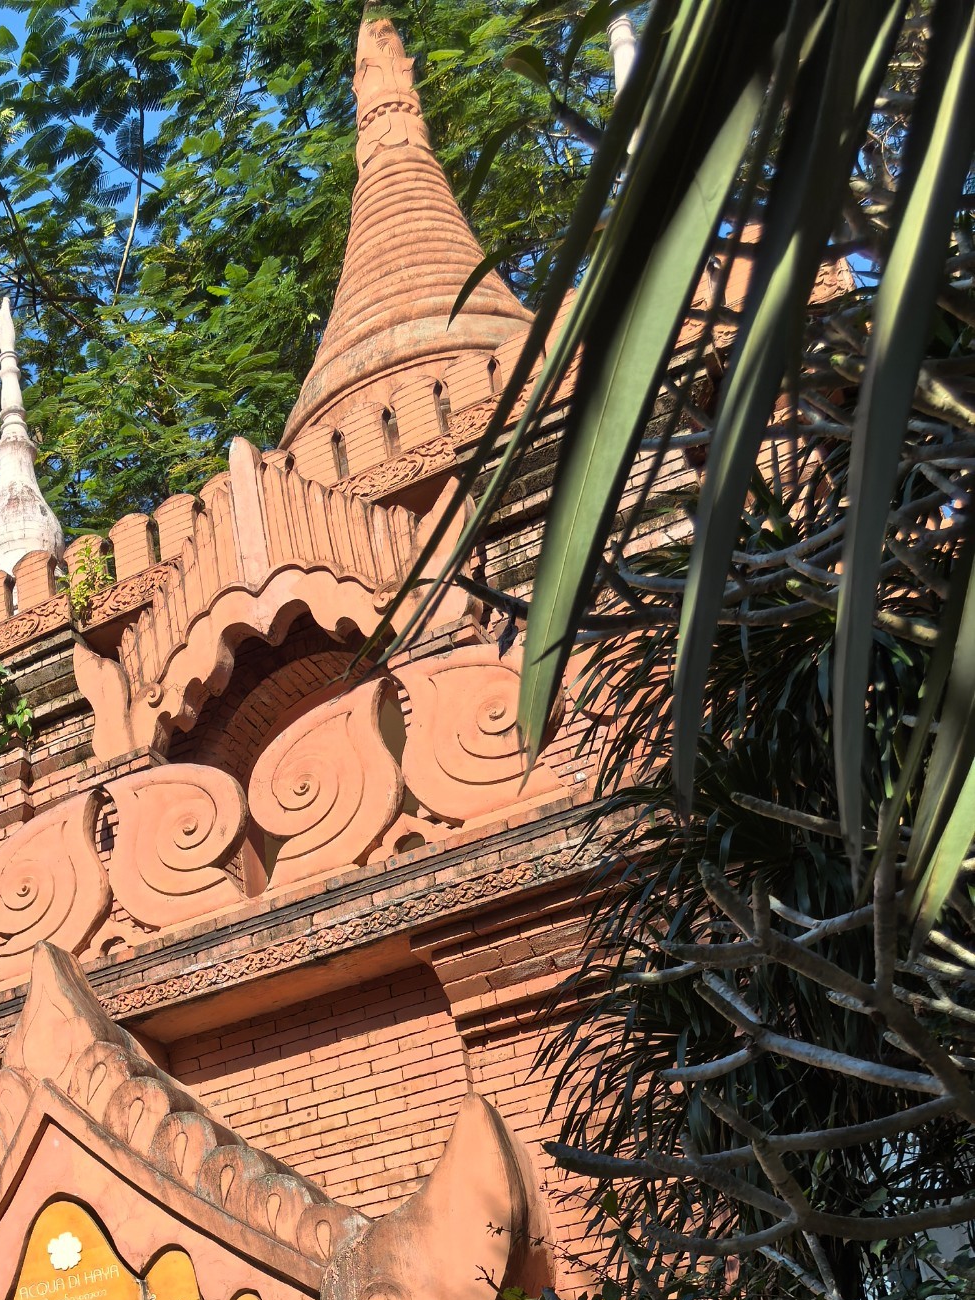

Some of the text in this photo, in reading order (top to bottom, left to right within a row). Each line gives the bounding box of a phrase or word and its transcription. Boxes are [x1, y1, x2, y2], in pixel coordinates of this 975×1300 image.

[19, 1264, 120, 1300] ACQUA DI HAYA
